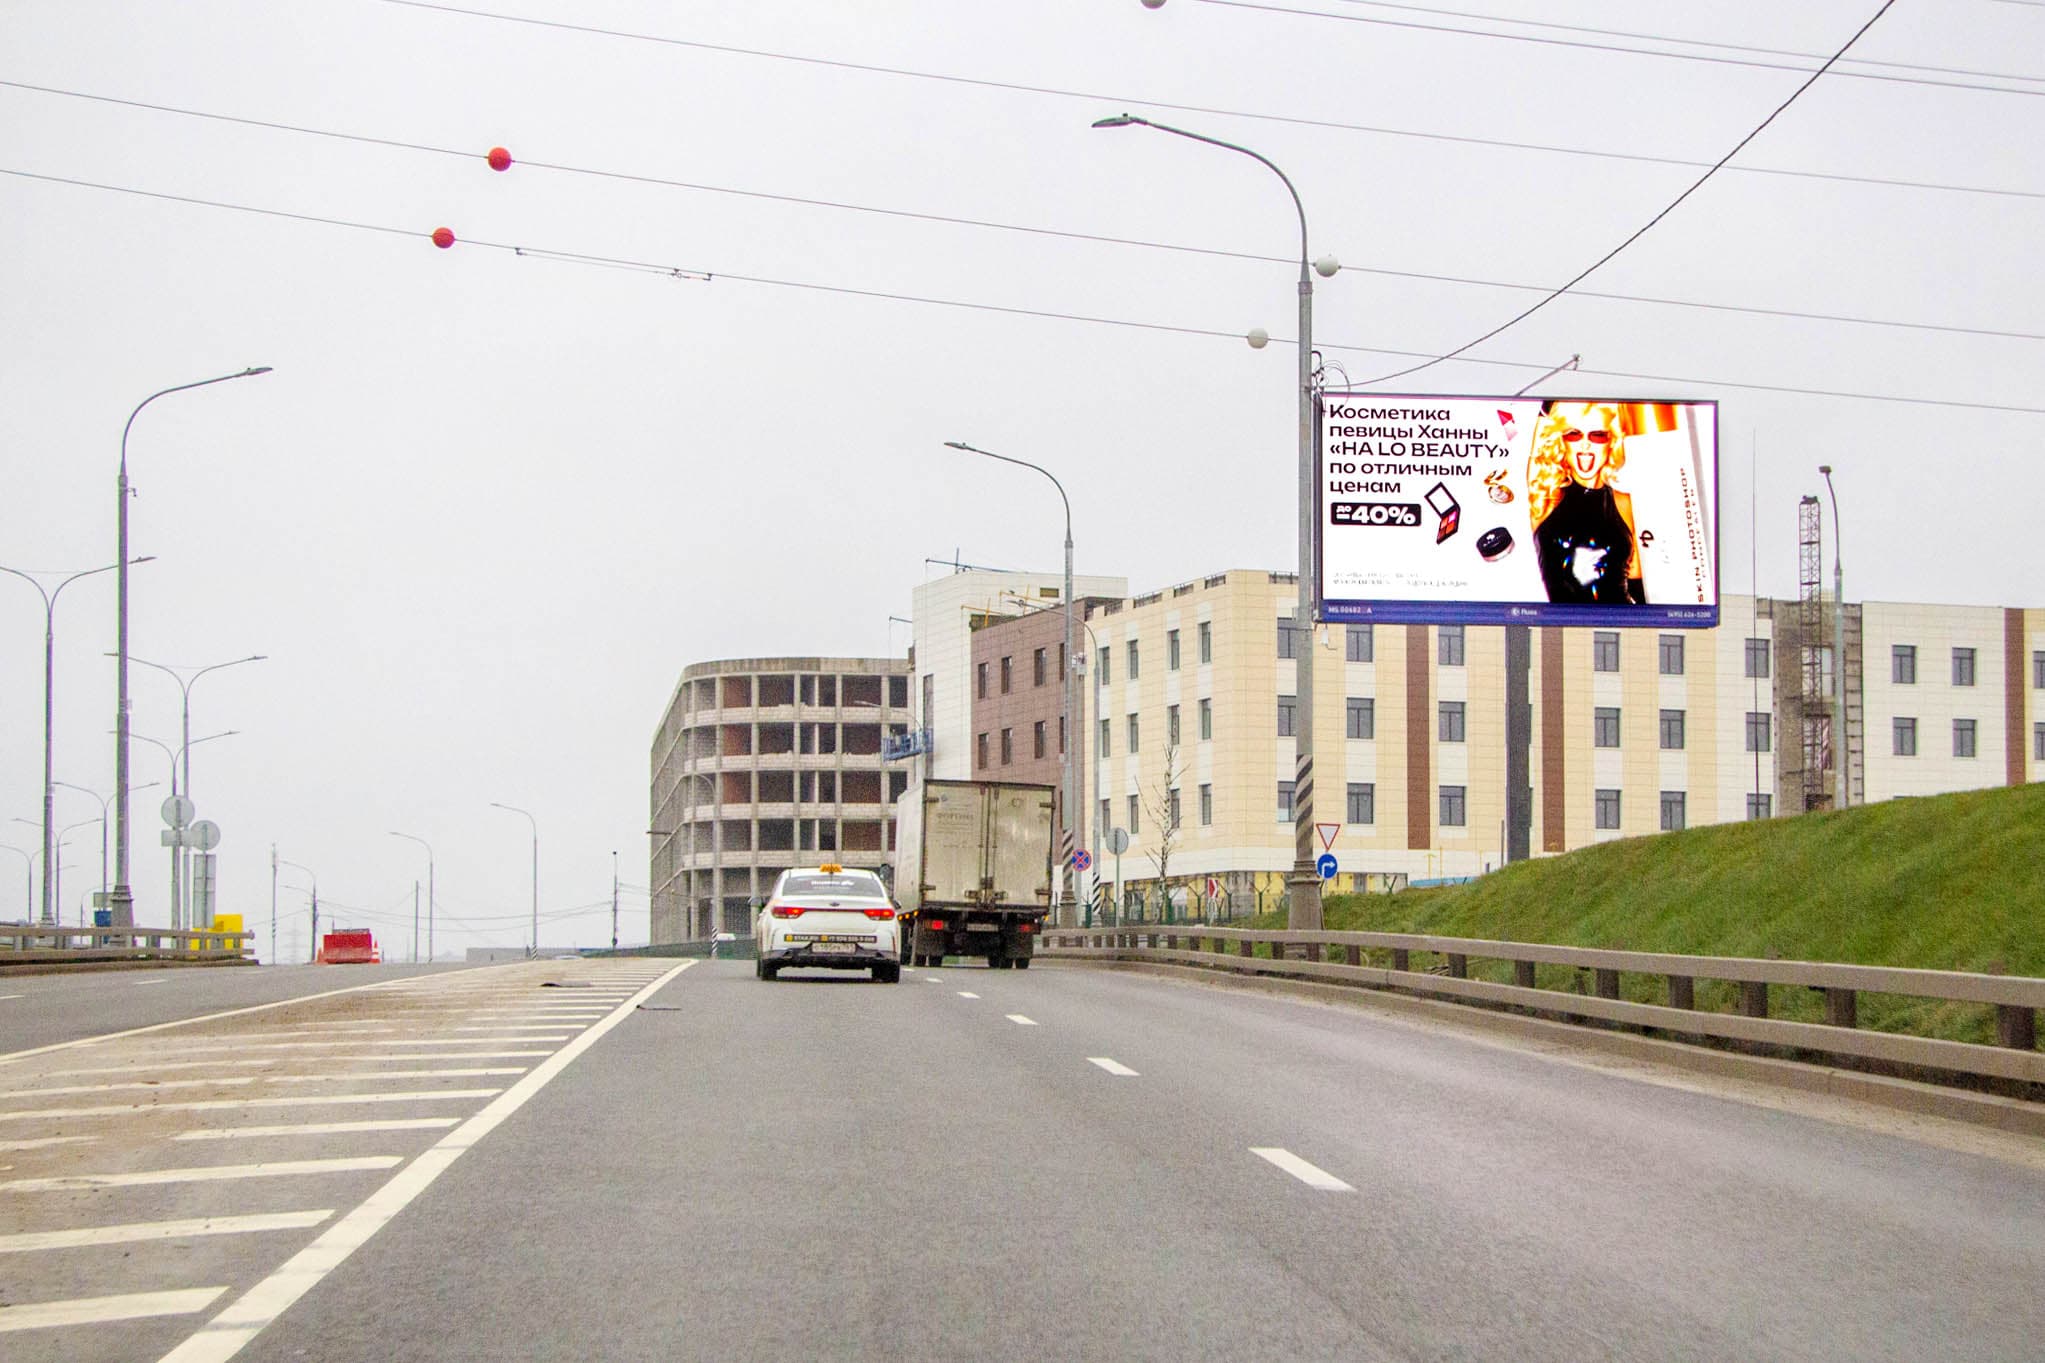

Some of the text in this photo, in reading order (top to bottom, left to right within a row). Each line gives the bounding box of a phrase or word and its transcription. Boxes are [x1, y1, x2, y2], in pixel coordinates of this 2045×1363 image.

[1329, 404, 1450, 421] Косметика
[1329, 424, 1488, 441] певицы Ханны
[1411, 442, 1510, 459] BEAUTY»
[1329, 462, 1472, 476] по отличным
[1329, 480, 1401, 494] ценам
[1336, 505, 1352, 513] до
